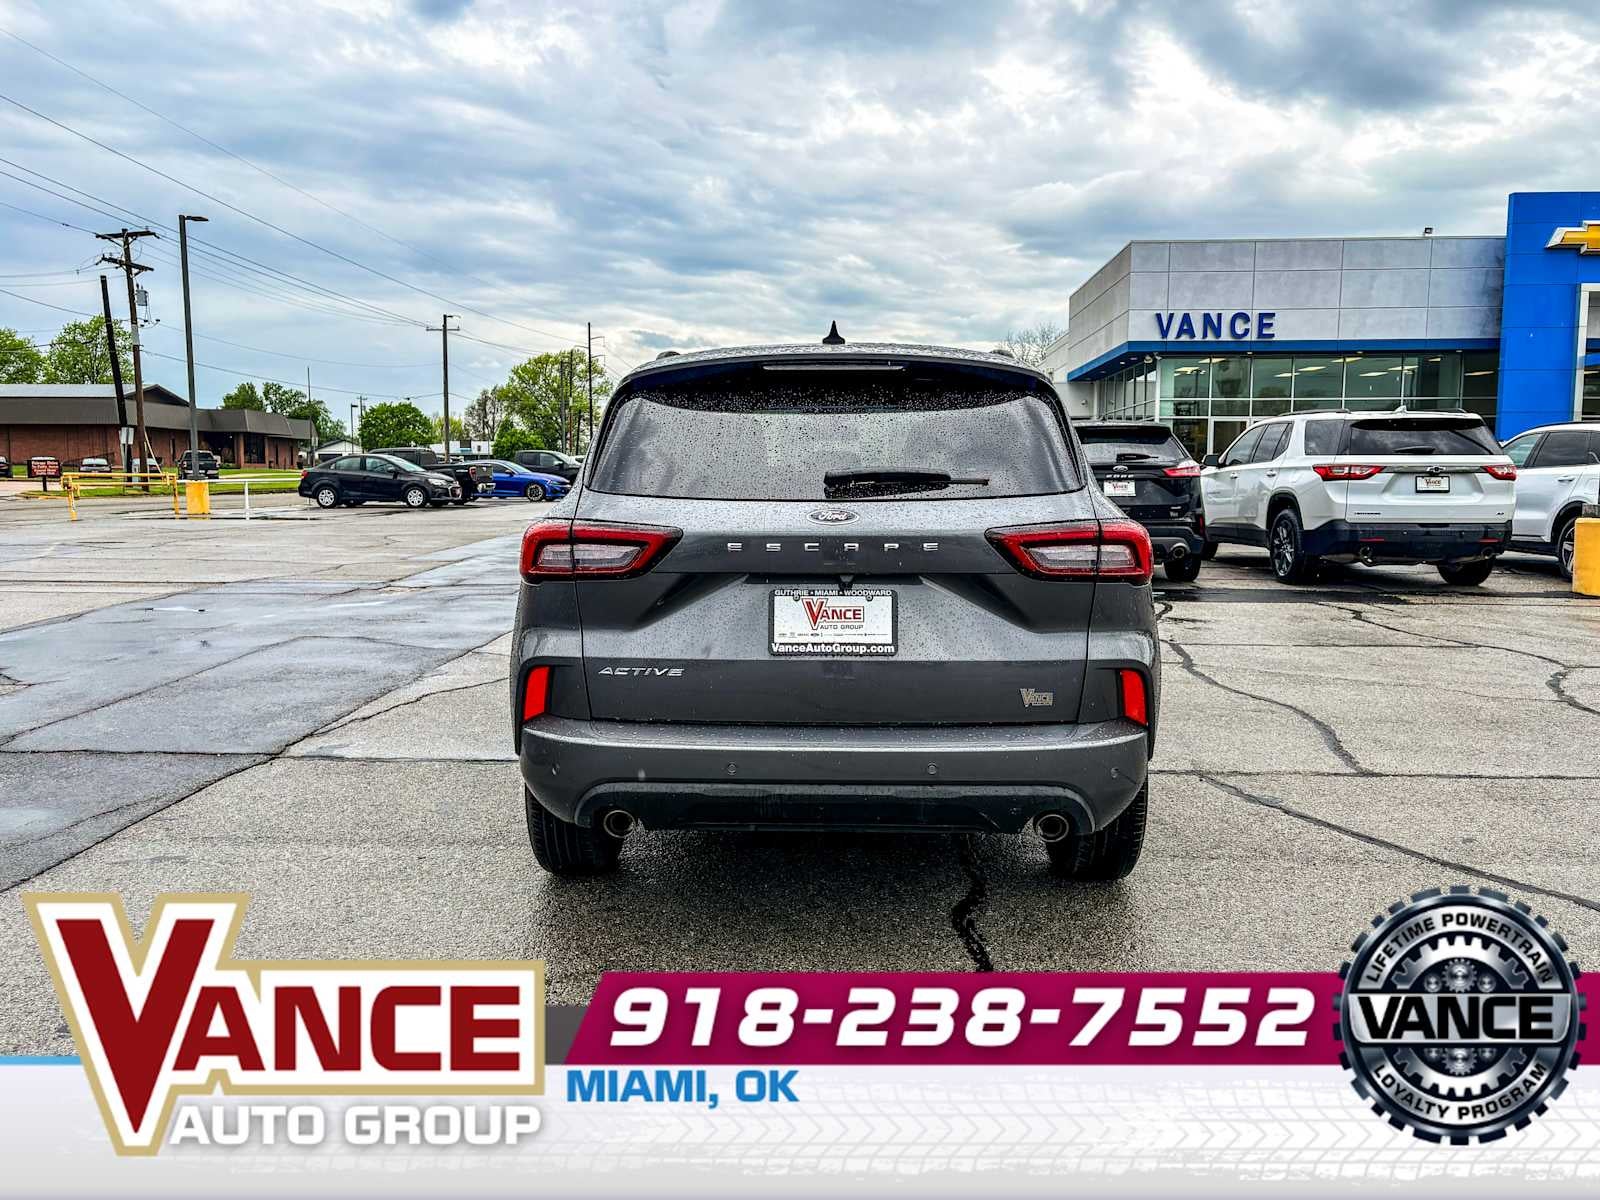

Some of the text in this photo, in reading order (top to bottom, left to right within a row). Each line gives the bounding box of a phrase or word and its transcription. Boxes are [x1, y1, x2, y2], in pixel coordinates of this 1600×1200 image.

[1155, 311, 1276, 339] VANCE
[727, 543, 939, 551] ESCAPE
[804, 600, 862, 627] VANCE
[772, 643, 895, 654] VanceAutoGroup.com
[598, 667, 685, 677] ACTIVE
